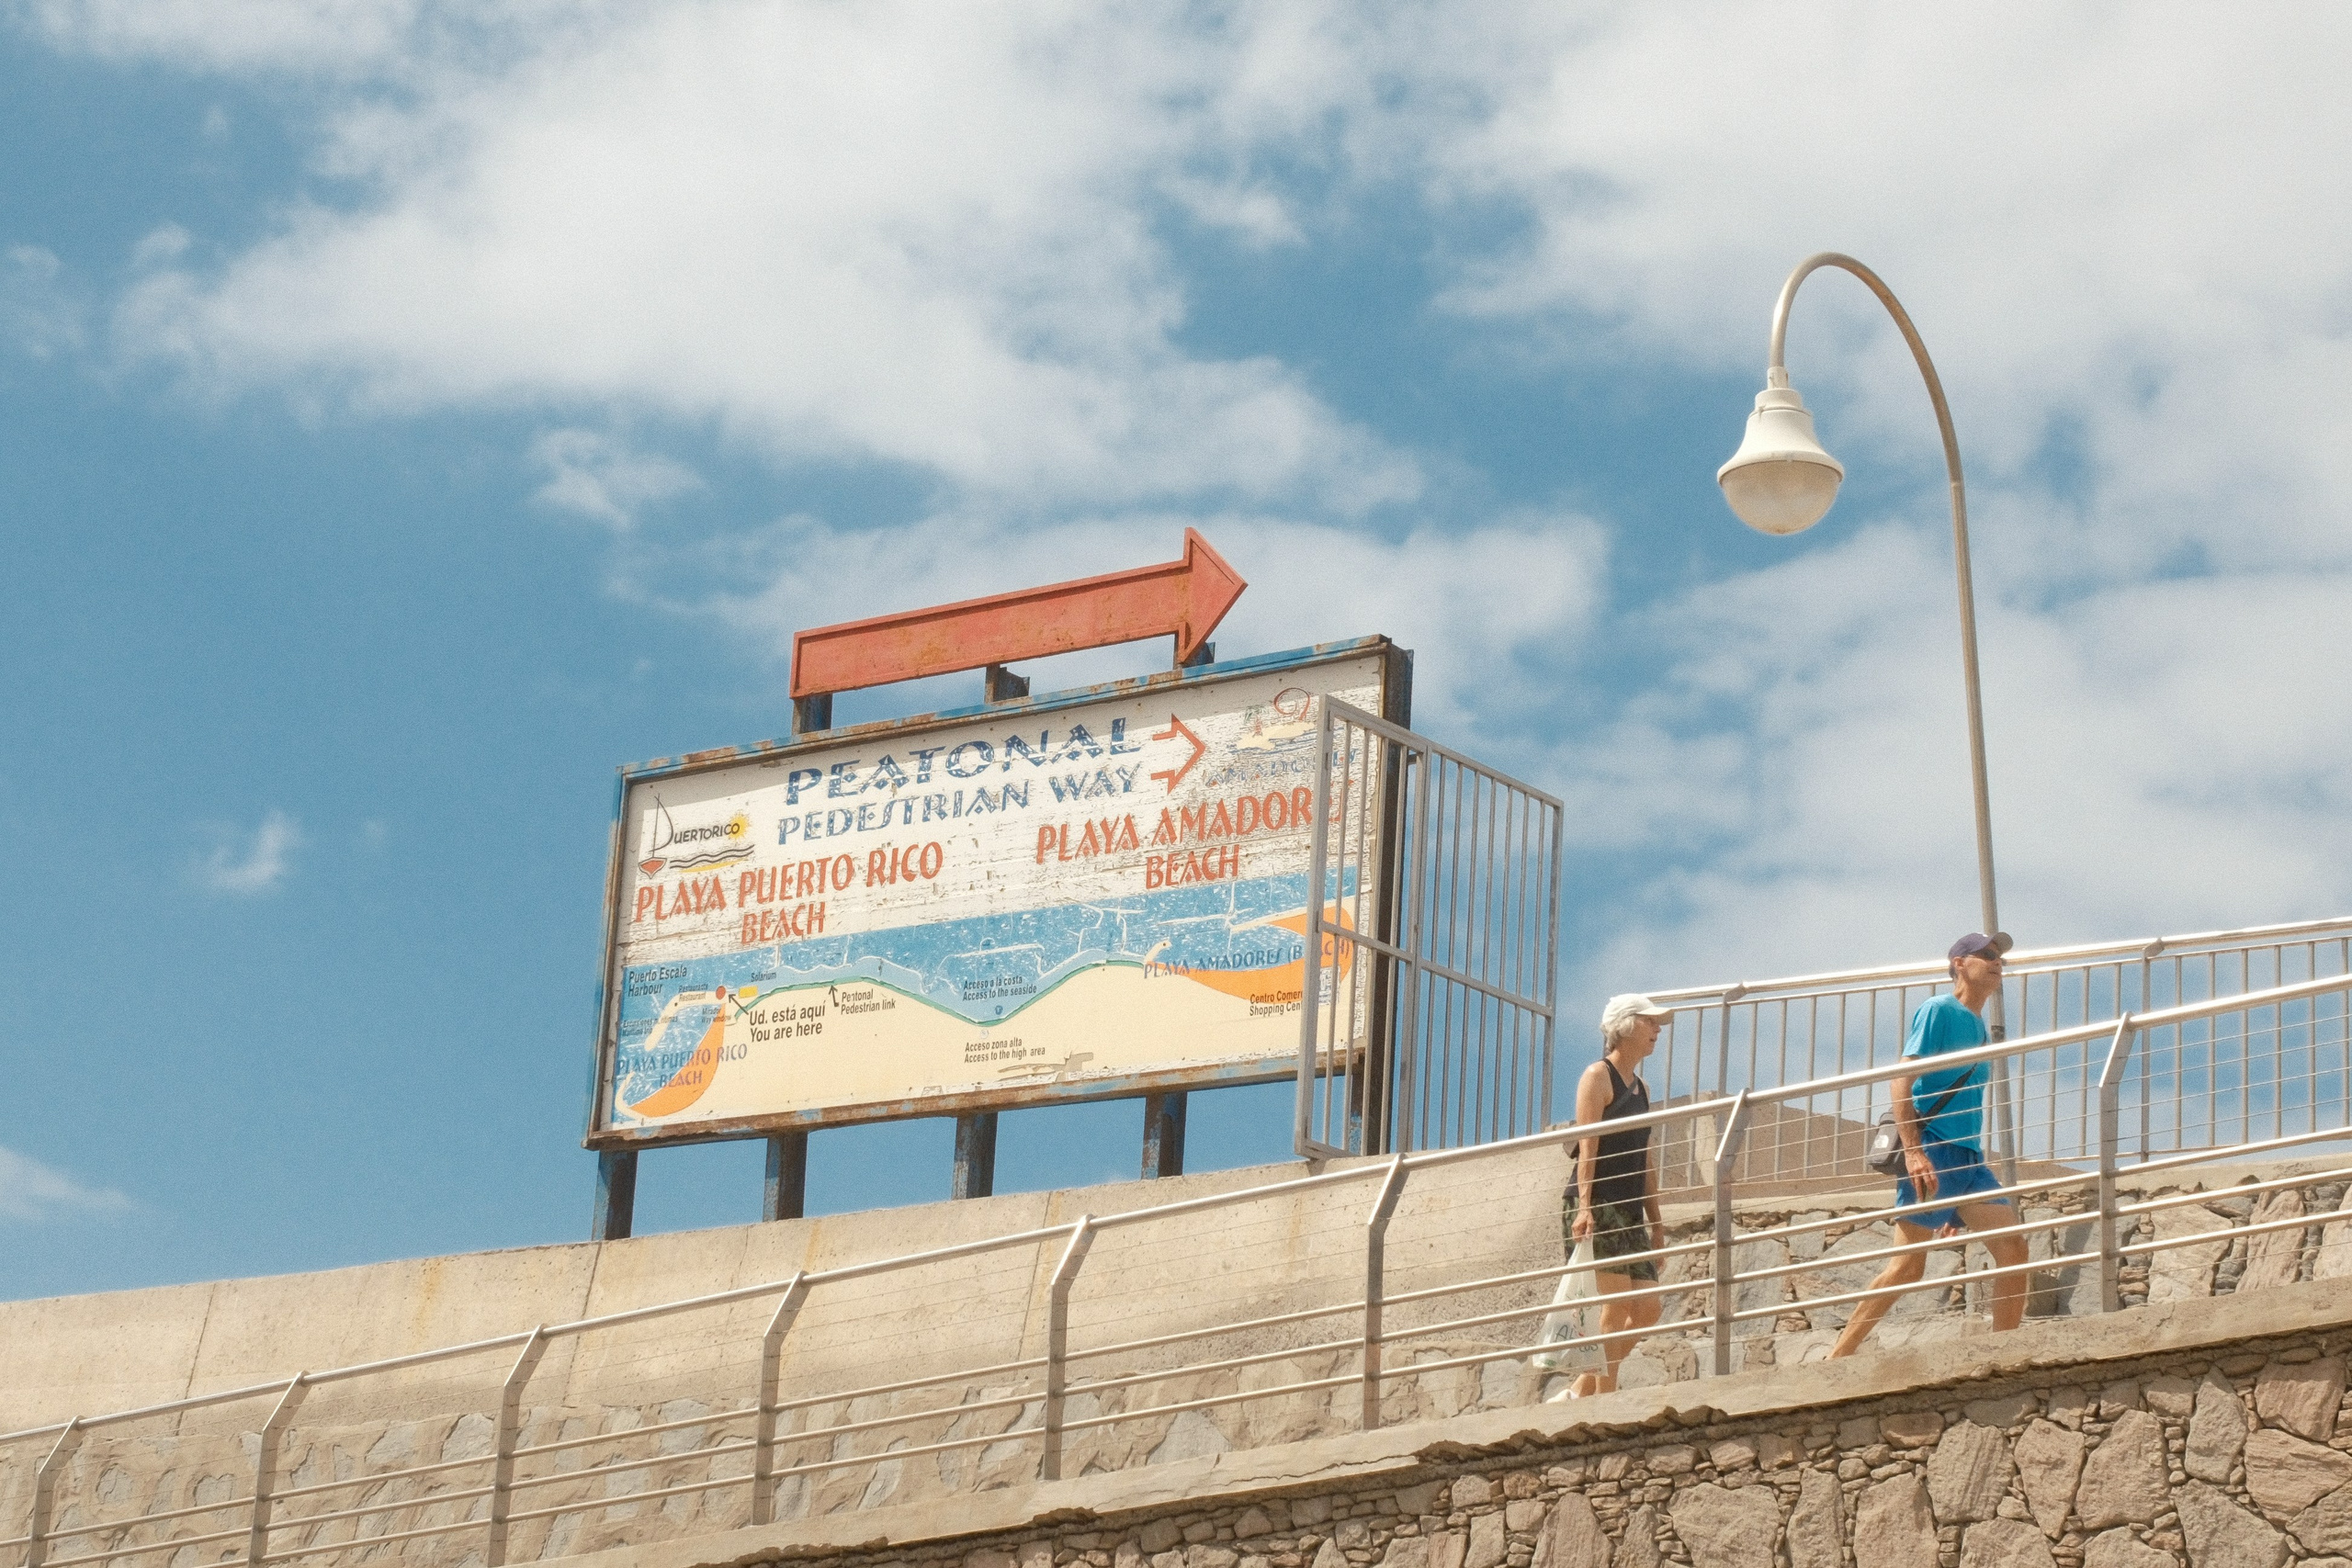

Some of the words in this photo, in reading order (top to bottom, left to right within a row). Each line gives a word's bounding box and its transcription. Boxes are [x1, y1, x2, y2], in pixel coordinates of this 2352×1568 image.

[786, 717, 1142, 806] PEATONAL
[778, 779, 1029, 845] PEDESTRIAN
[1048, 761, 1140, 804] WAY
[1035, 813, 1140, 864] PLAYA
[1146, 844, 1239, 890] BEACH
[635, 875, 727, 922] PLAYA
[739, 853, 854, 908] PUERTO
[866, 841, 943, 888] RICO
[741, 902, 825, 944] BEACH
[1144, 958, 1190, 979] PLAYA
[1194, 948, 1283, 974] AMADORES
[1288, 939, 1350, 964] (BCH)
[628, 968, 657, 984] Puerto
[751, 971, 777, 983] Solarium
[963, 980, 989, 990] Acceso
[1003, 976, 1023, 986] costa
[628, 983, 663, 998] Harbour
[963, 991, 988, 1001] Access
[989, 989, 997, 998] to
[998, 987, 1009, 998] the
[1011, 984, 1037, 996] seaside
[1250, 993, 1275, 1004] Centro
[1276, 990, 1303, 1001] Comer
[749, 1009, 769, 1026] Ud.
[772, 1004, 797, 1023] está
[800, 999, 826, 1022] aquí
[841, 1000, 880, 1015] Pedestrian
[882, 998, 897, 1010] link
[1250, 1001, 1284, 1017] Shopping
[750, 1027, 771, 1043] You
[774, 1025, 793, 1041] are
[796, 1021, 822, 1038] here
[717, 1043, 748, 1063] RICO
[965, 1042, 989, 1052] Acceso
[991, 1039, 1008, 1049] zona
[1010, 1037, 1023, 1047] alta
[964, 1053, 989, 1063] Access
[990, 1051, 998, 1060] to
[999, 1049, 1010, 1059] the
[1012, 1047, 1027, 1060] high
[1030, 1047, 1046, 1056] area
[660, 1070, 703, 1088] BEACH
